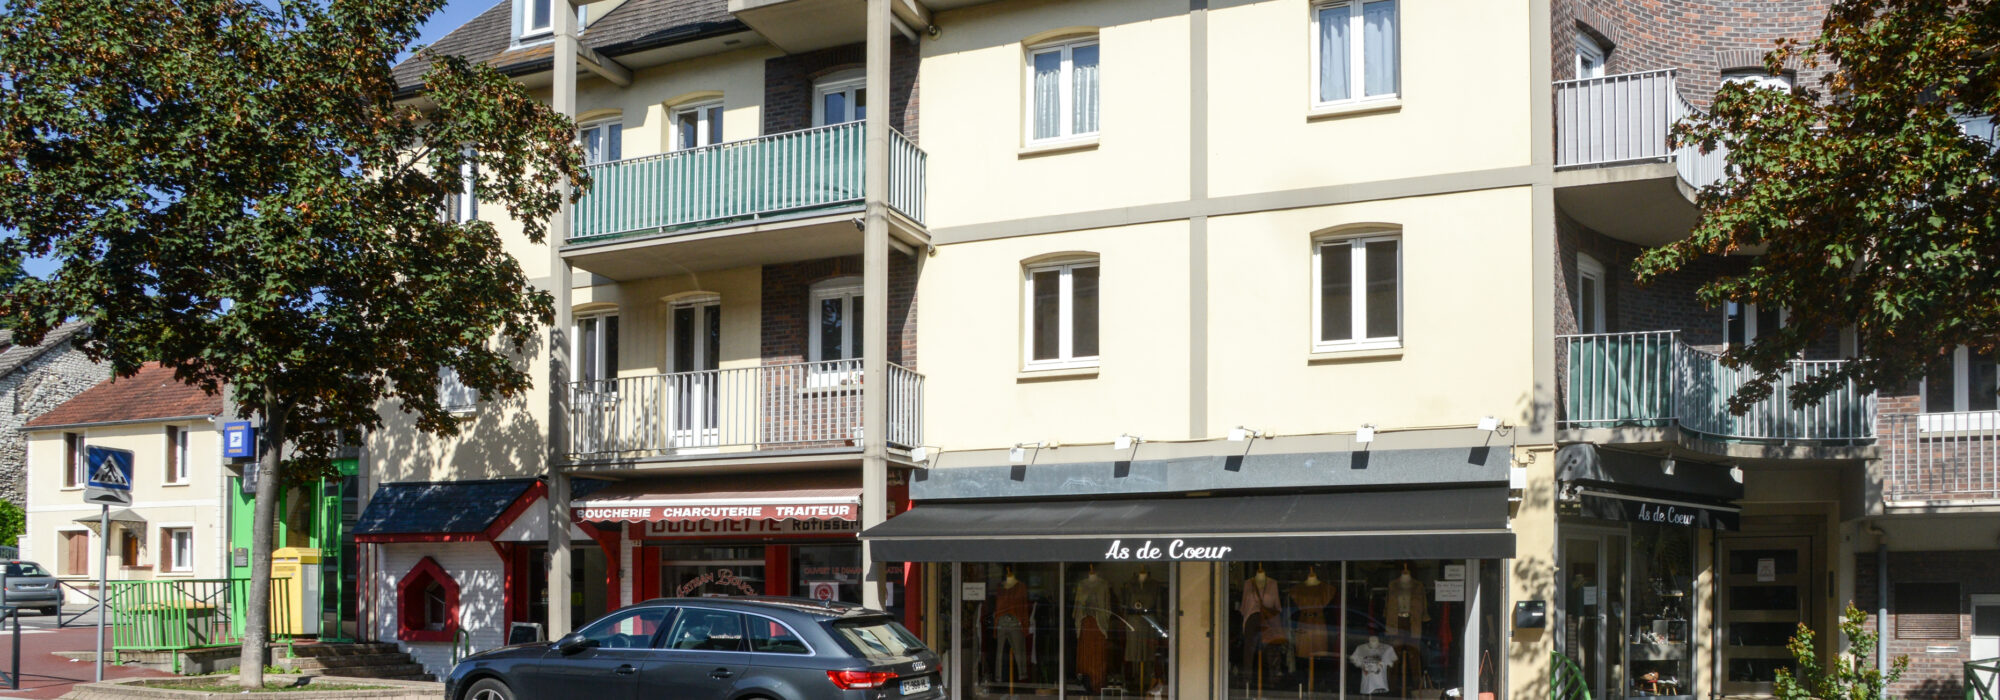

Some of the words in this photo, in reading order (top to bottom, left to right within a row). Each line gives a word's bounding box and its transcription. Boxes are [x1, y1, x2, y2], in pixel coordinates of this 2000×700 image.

[577, 508, 652, 518] BOUCHERIE
[663, 507, 762, 517] CHARCUTERIE
[775, 505, 850, 516] TRAITEUR
[1638, 503, 1650, 520] As
[1653, 506, 1665, 522] de
[792, 518, 863, 531] Rotisseri
[1105, 540, 1130, 559] As
[1136, 540, 1162, 559] de
